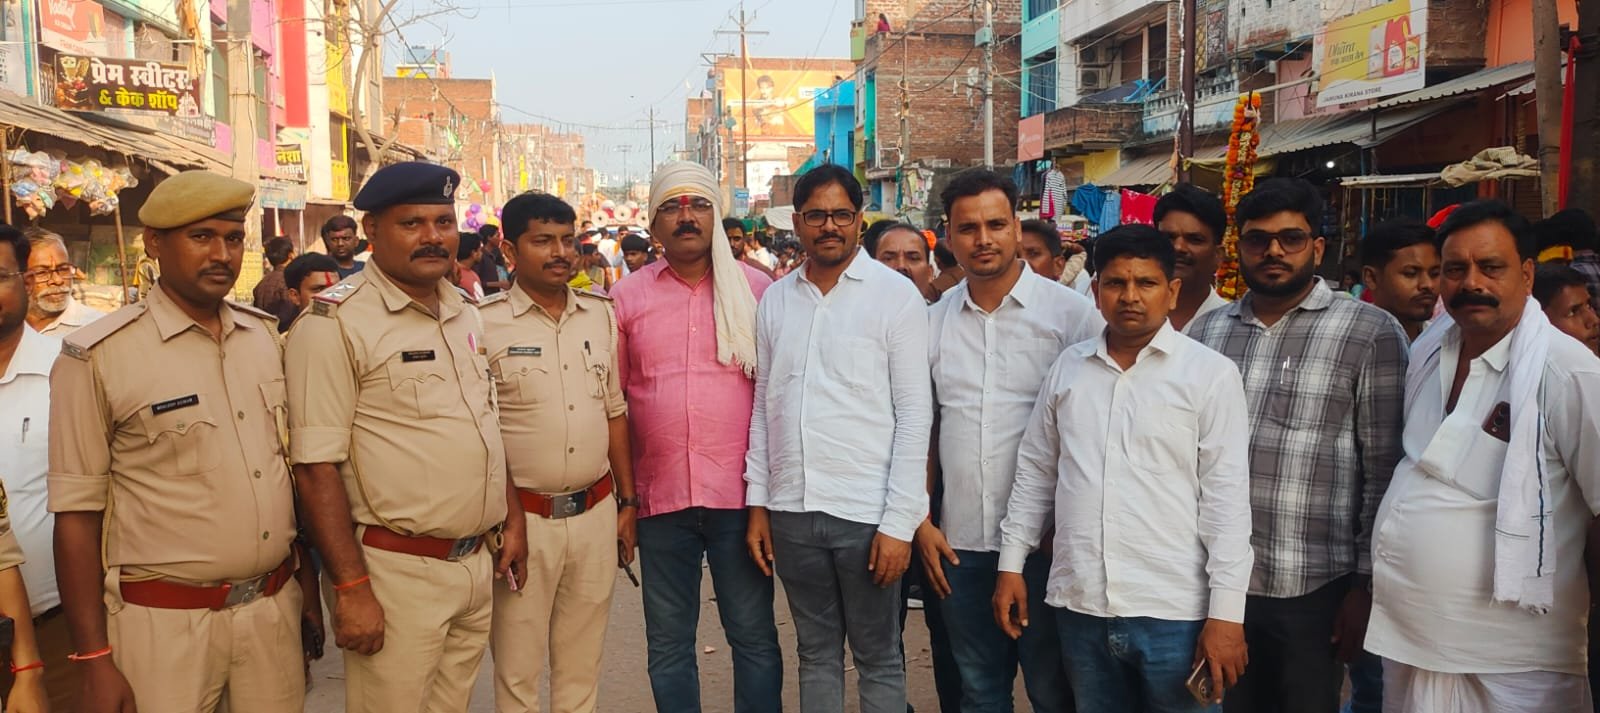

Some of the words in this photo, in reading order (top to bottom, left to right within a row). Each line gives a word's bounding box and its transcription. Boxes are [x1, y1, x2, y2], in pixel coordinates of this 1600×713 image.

[90, 57, 125, 85] प्रेम
[99, 89, 113, 106] &
[115, 87, 145, 107] केक
[147, 90, 178, 110] शॉप
